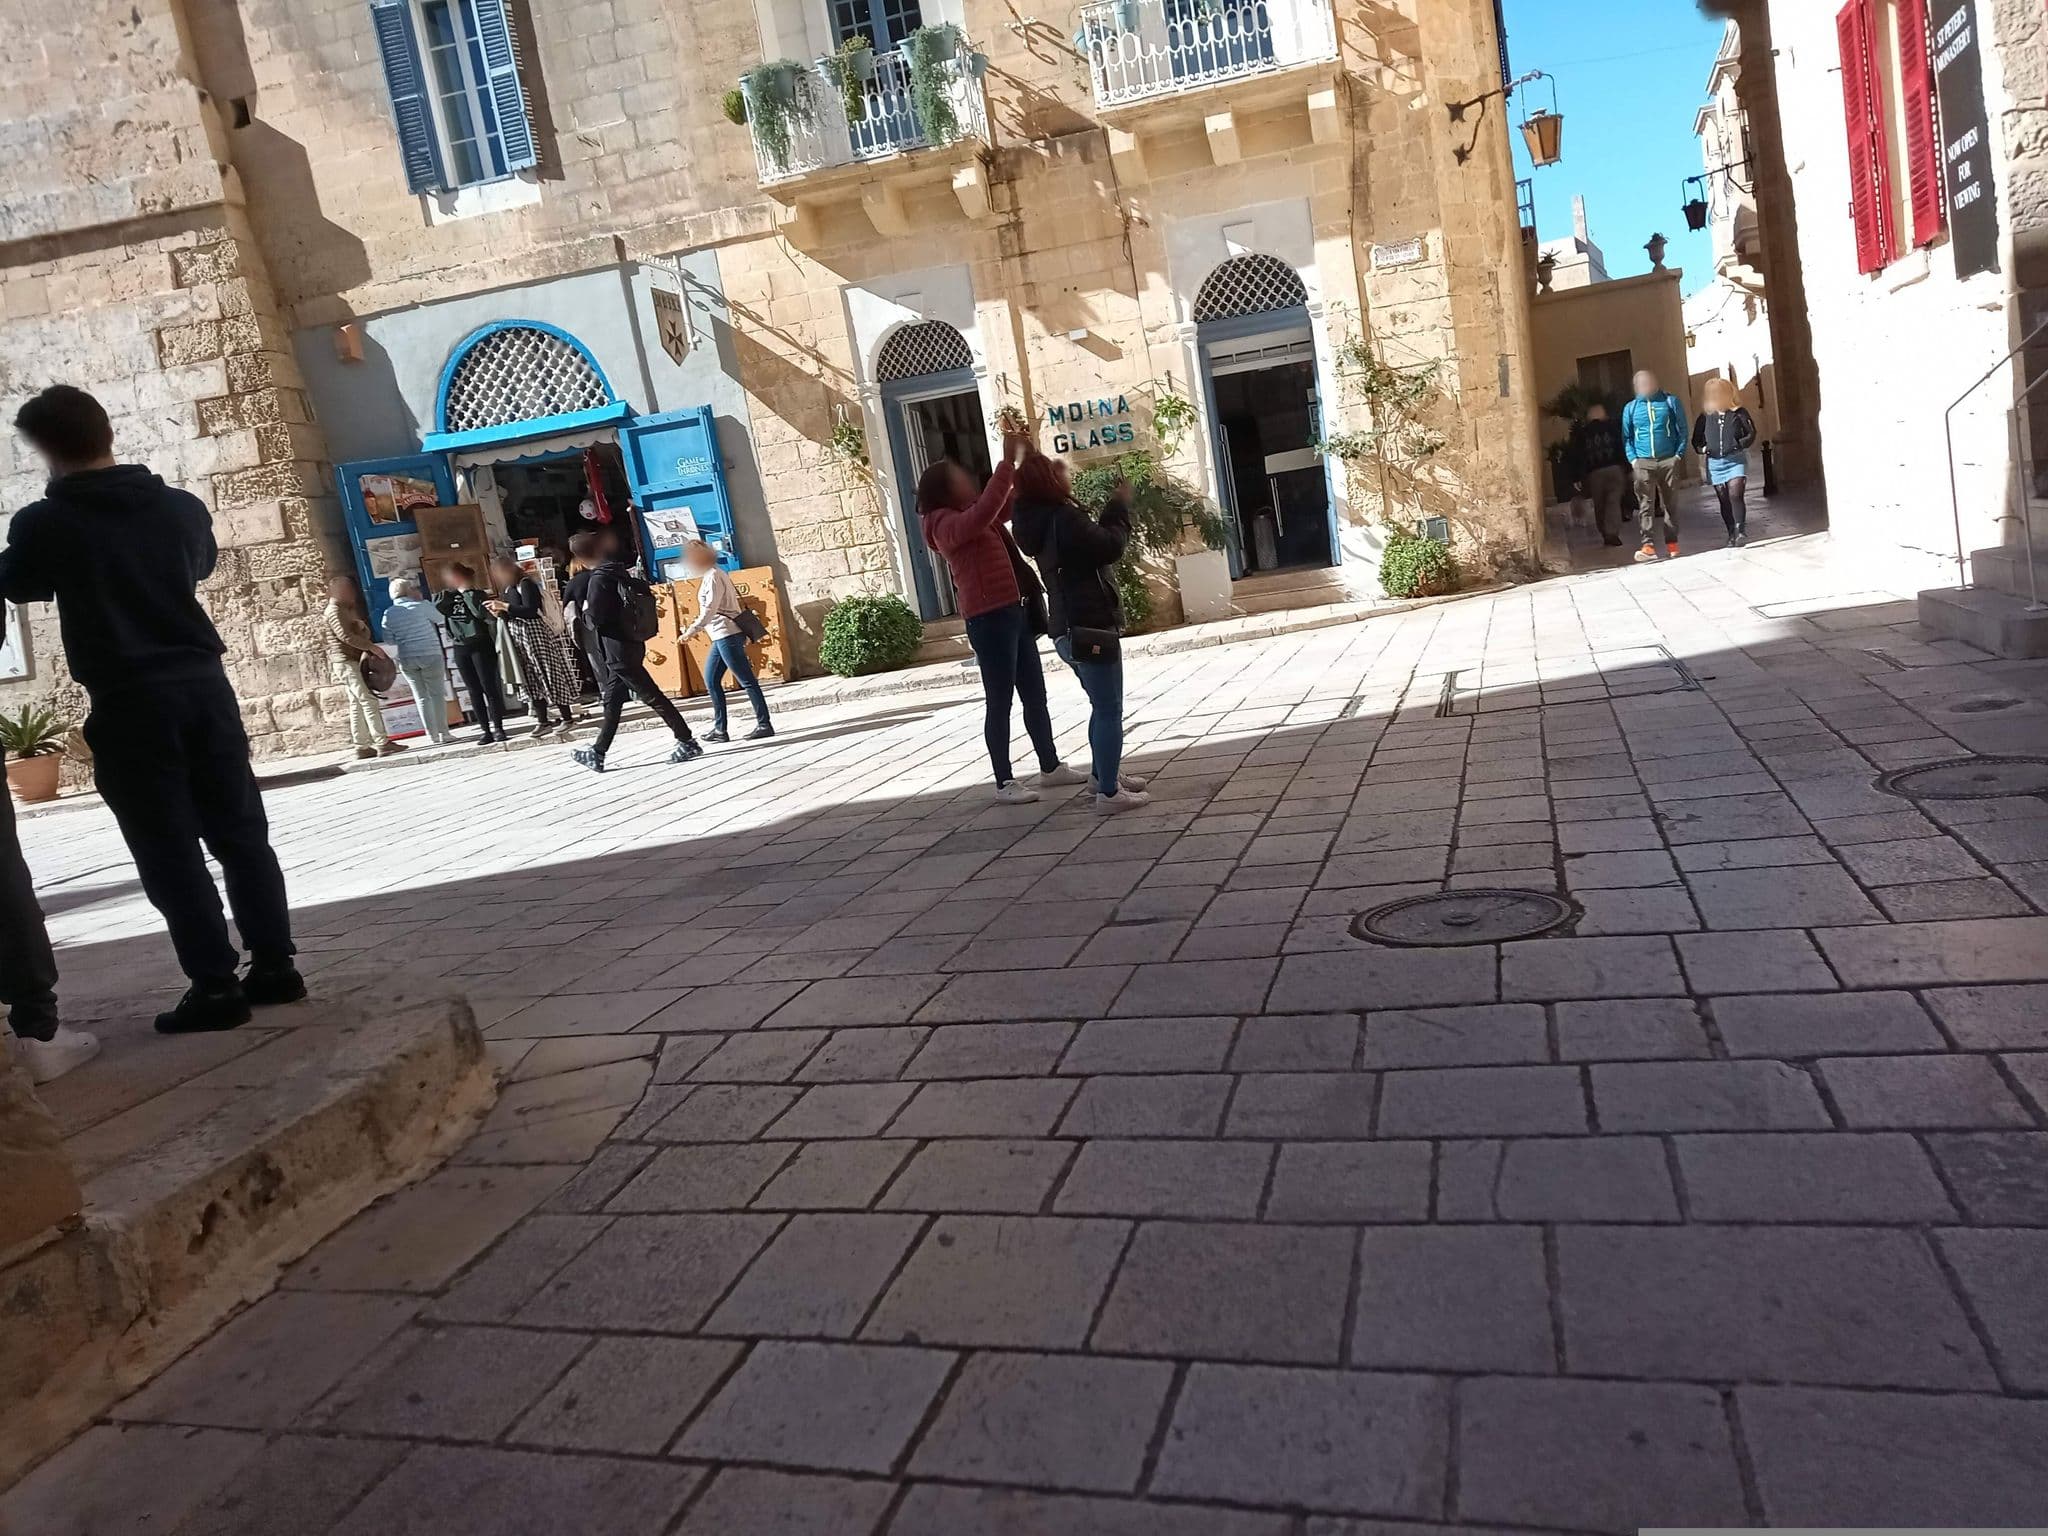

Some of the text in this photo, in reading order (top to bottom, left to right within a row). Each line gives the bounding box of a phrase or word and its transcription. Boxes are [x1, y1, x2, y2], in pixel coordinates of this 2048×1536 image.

[1936, 25, 1971, 73] MONASTERY
[1947, 126, 1979, 164] NOW OPEN
[1957, 160, 1972, 183] FOR
[1953, 181, 1981, 210] VIEWING
[1048, 394, 1130, 426] MDINA
[1054, 423, 1134, 454] GLASS
